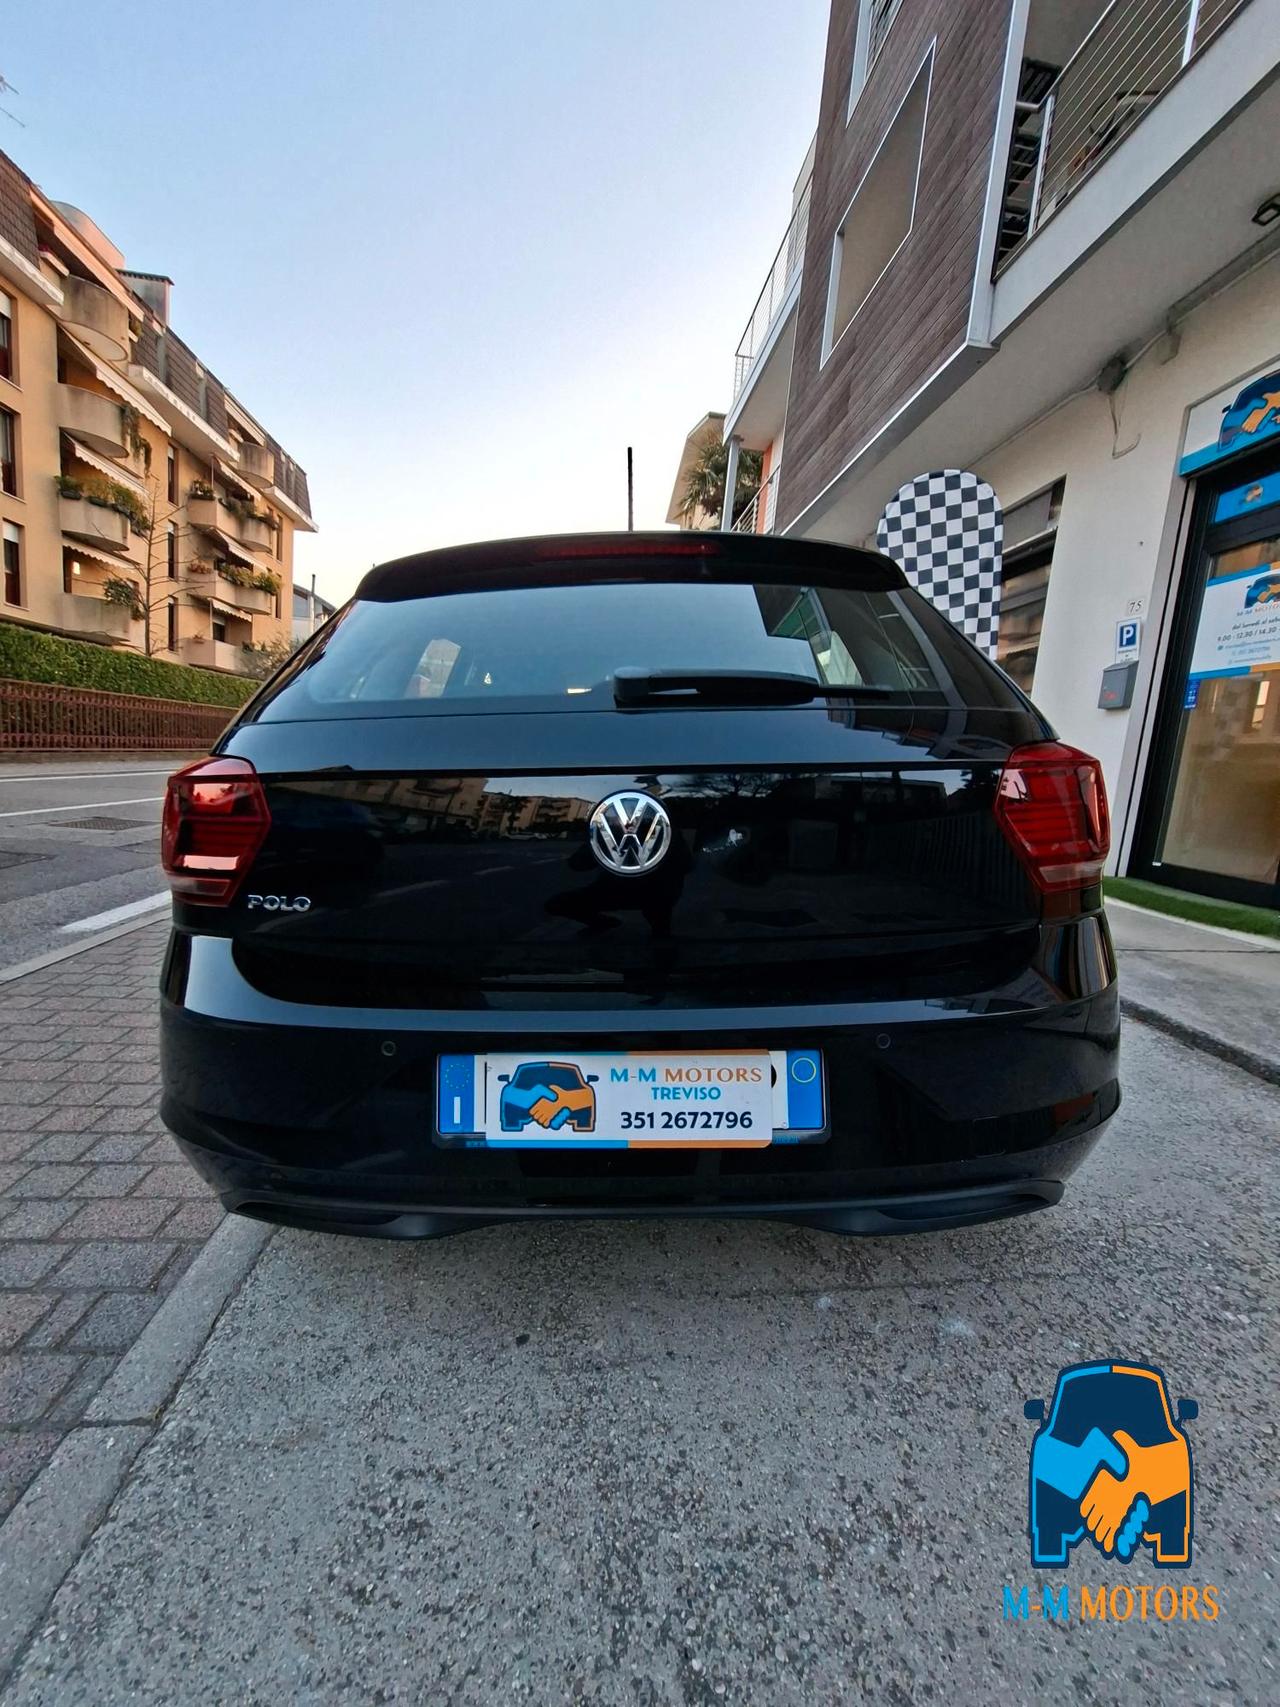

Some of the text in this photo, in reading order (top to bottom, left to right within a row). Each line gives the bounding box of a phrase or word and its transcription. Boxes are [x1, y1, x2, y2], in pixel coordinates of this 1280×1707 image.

[1129, 600, 1142, 613] 75
[1122, 625, 1134, 646] P
[247, 894, 311, 912] POLO
[610, 1067, 762, 1083] M-M MOTORS
[651, 1087, 722, 1101] TREVISO
[453, 1096, 461, 1125] I
[620, 1111, 753, 1129] 351 2672796
